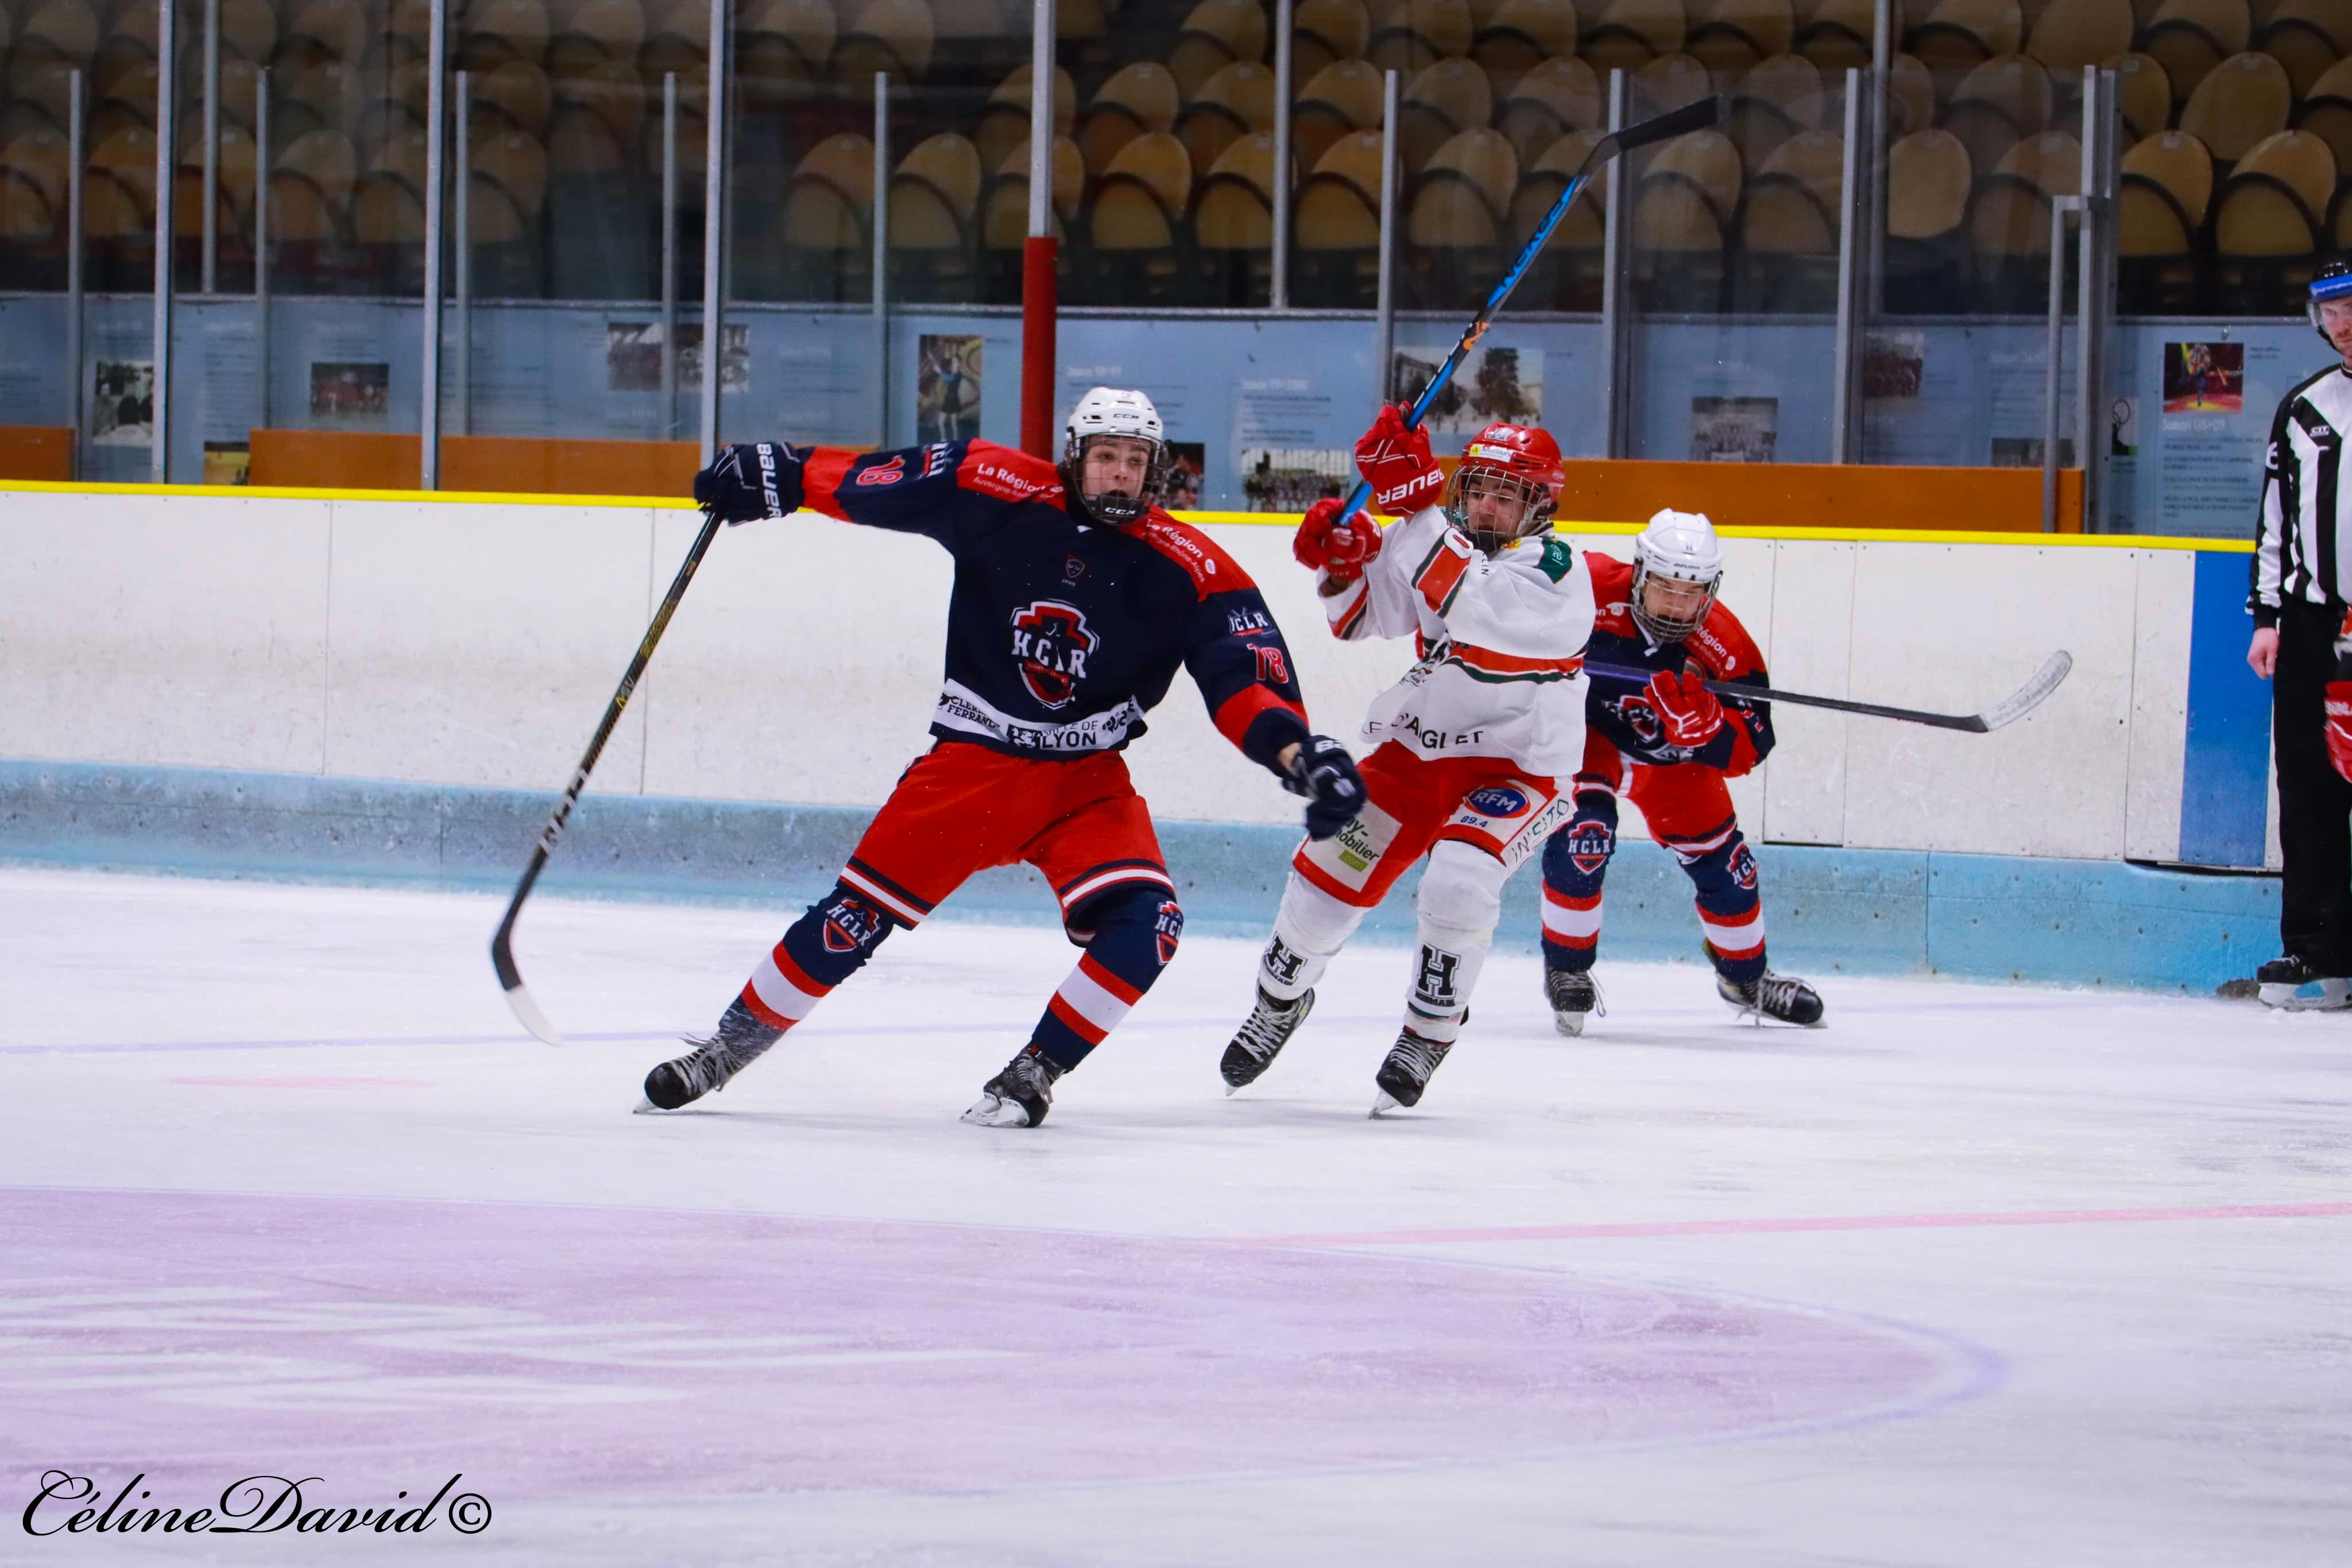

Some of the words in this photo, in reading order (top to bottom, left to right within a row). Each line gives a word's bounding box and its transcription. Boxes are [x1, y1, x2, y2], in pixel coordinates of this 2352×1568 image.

[977, 463, 995, 476] La
[1104, 506, 1136, 515] CCM
[1146, 518, 1160, 531] La
[1162, 526, 1204, 558] Région
[1246, 643, 1289, 684] 18
[1081, 721, 1098, 731] DE
[1042, 731, 1097, 749] LYON
[1472, 791, 1518, 812] RFM
[1460, 815, 1489, 828] 89.4
[1731, 857, 1755, 885] HCL
[827, 904, 872, 947] HCLR
[1415, 941, 1461, 999] H
